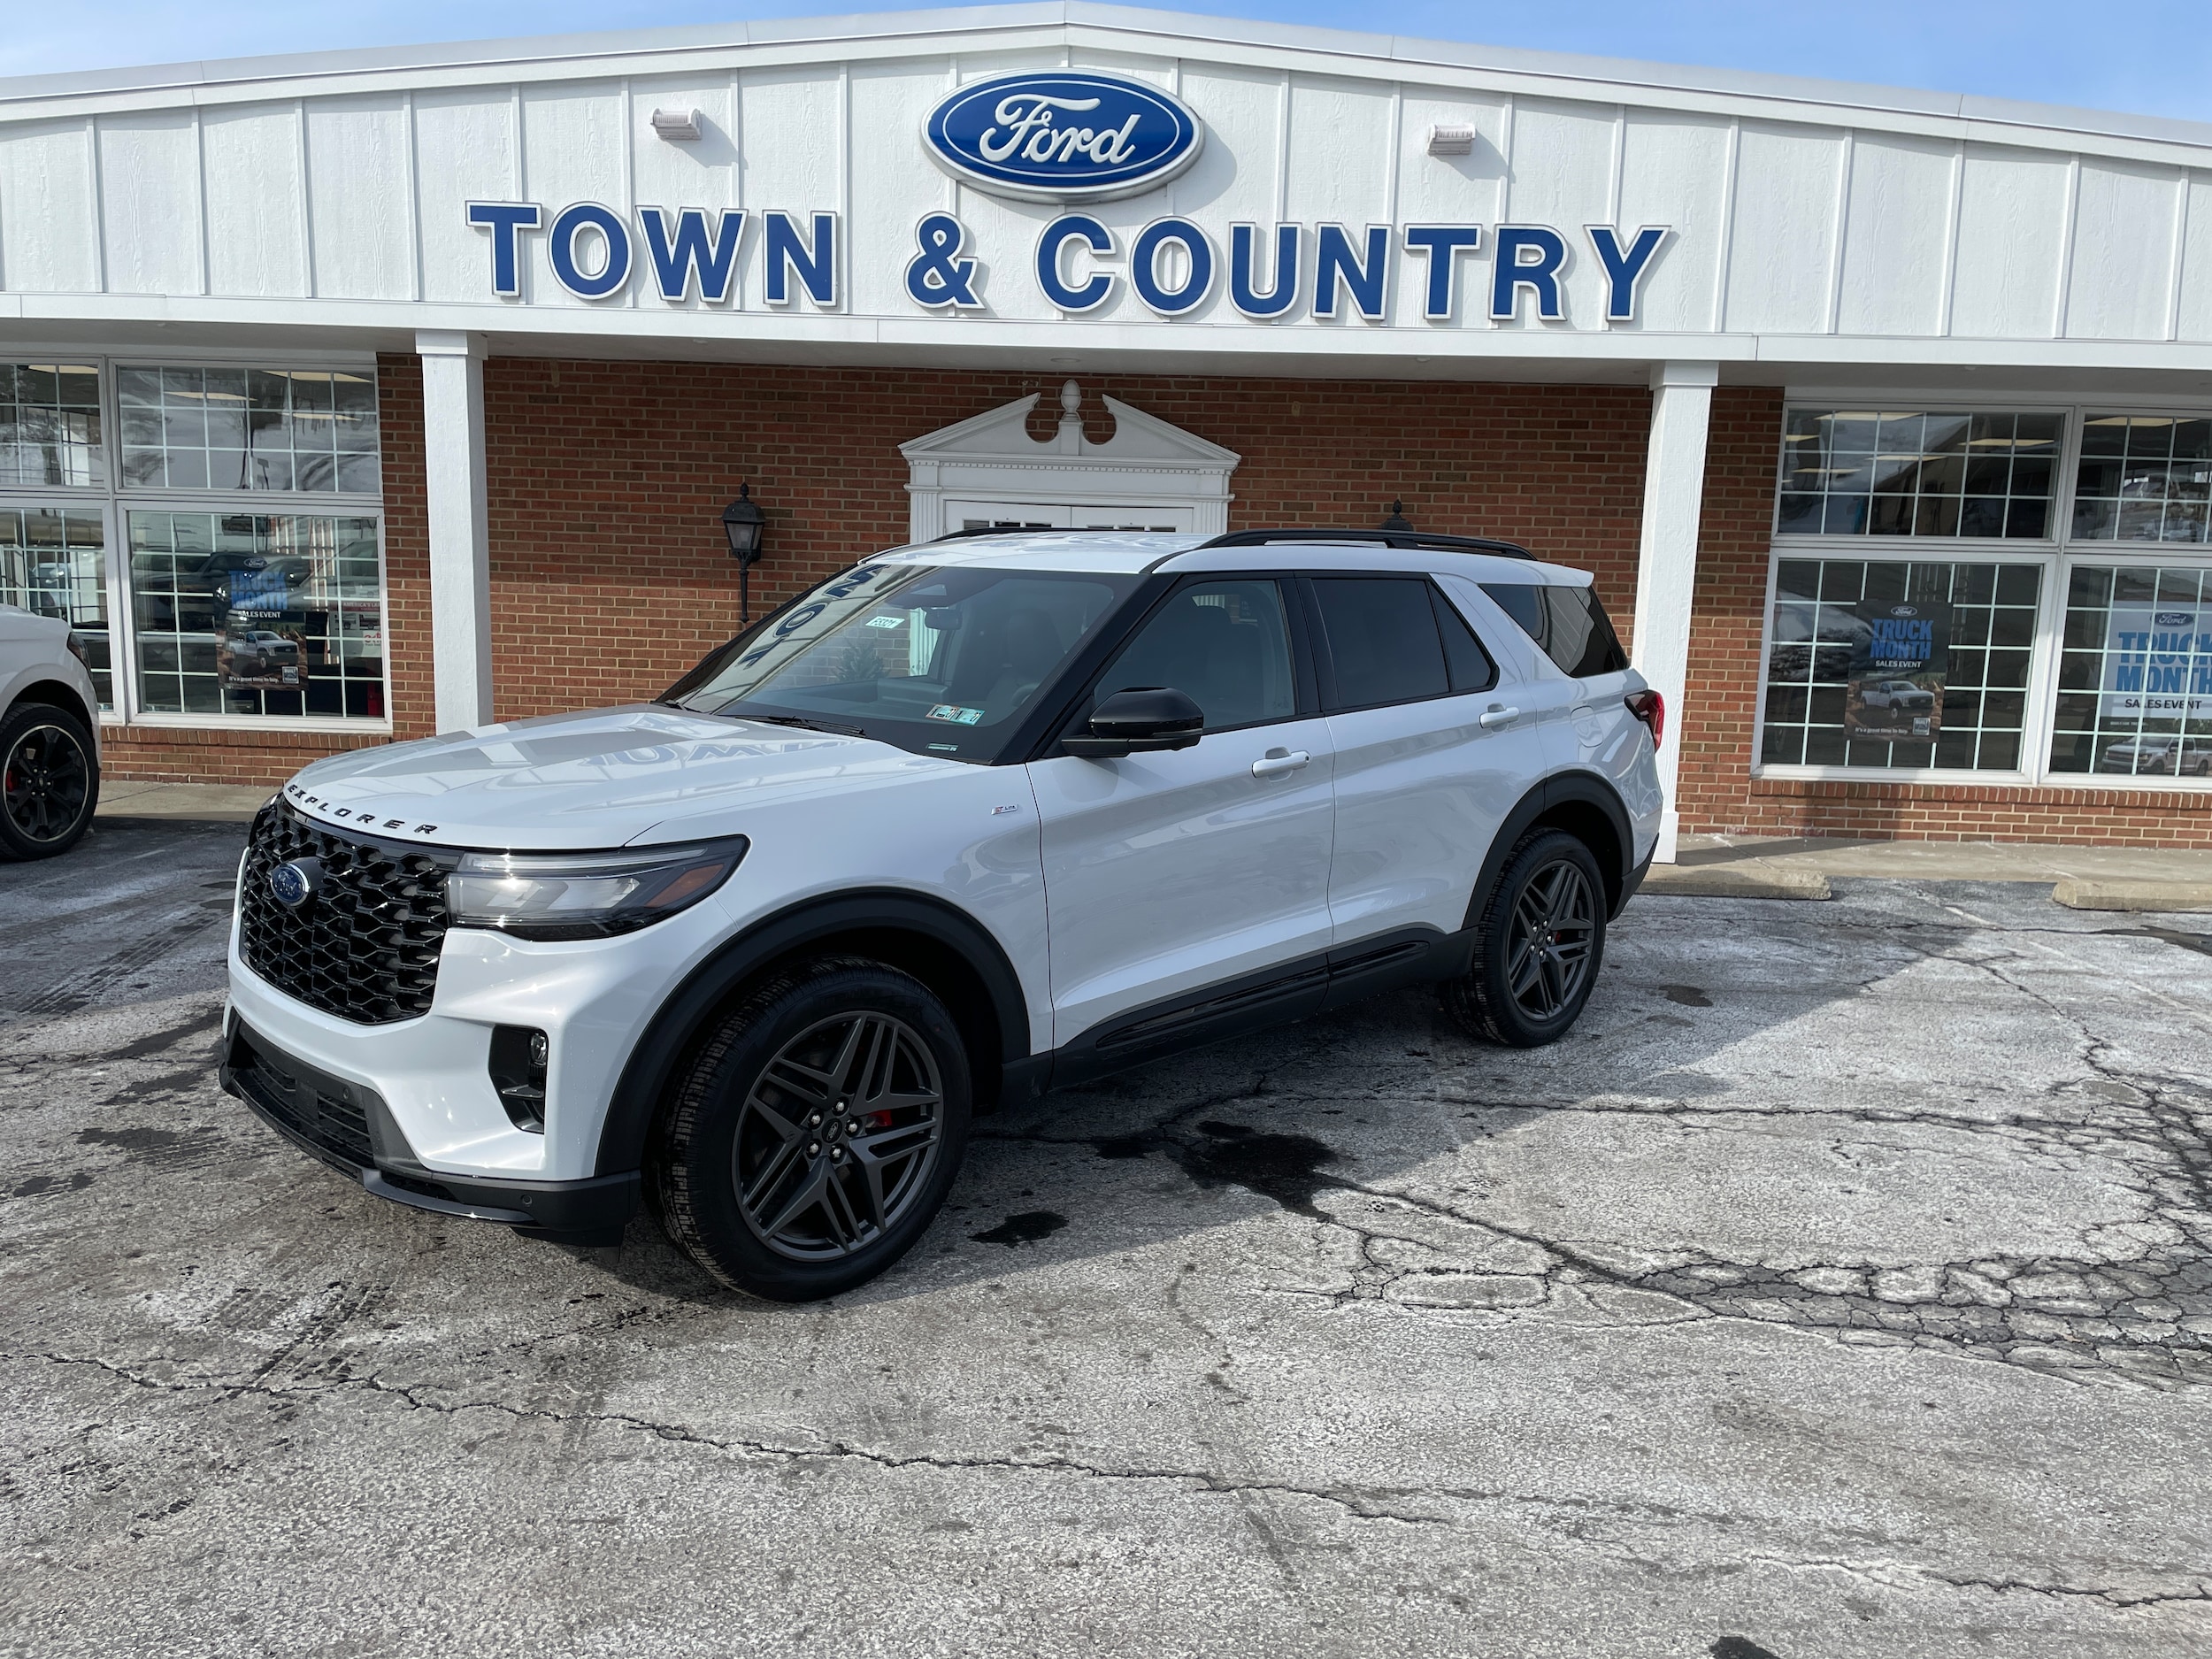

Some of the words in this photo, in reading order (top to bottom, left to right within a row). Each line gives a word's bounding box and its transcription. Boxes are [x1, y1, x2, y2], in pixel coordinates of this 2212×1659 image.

[979, 93, 1141, 164] Ford
[465, 200, 839, 308] TOWN
[903, 211, 987, 310] &
[1033, 211, 1672, 321] COUNTRY
[228, 571, 286, 590] TRUCK
[232, 590, 288, 610] MONTH
[2159, 613, 2186, 624] Ford
[1872, 618, 1933, 640] TRUCK
[1870, 639, 1932, 659] MONTH
[2124, 698, 2161, 709] SAES
[288, 784, 438, 834] EXPLORER
